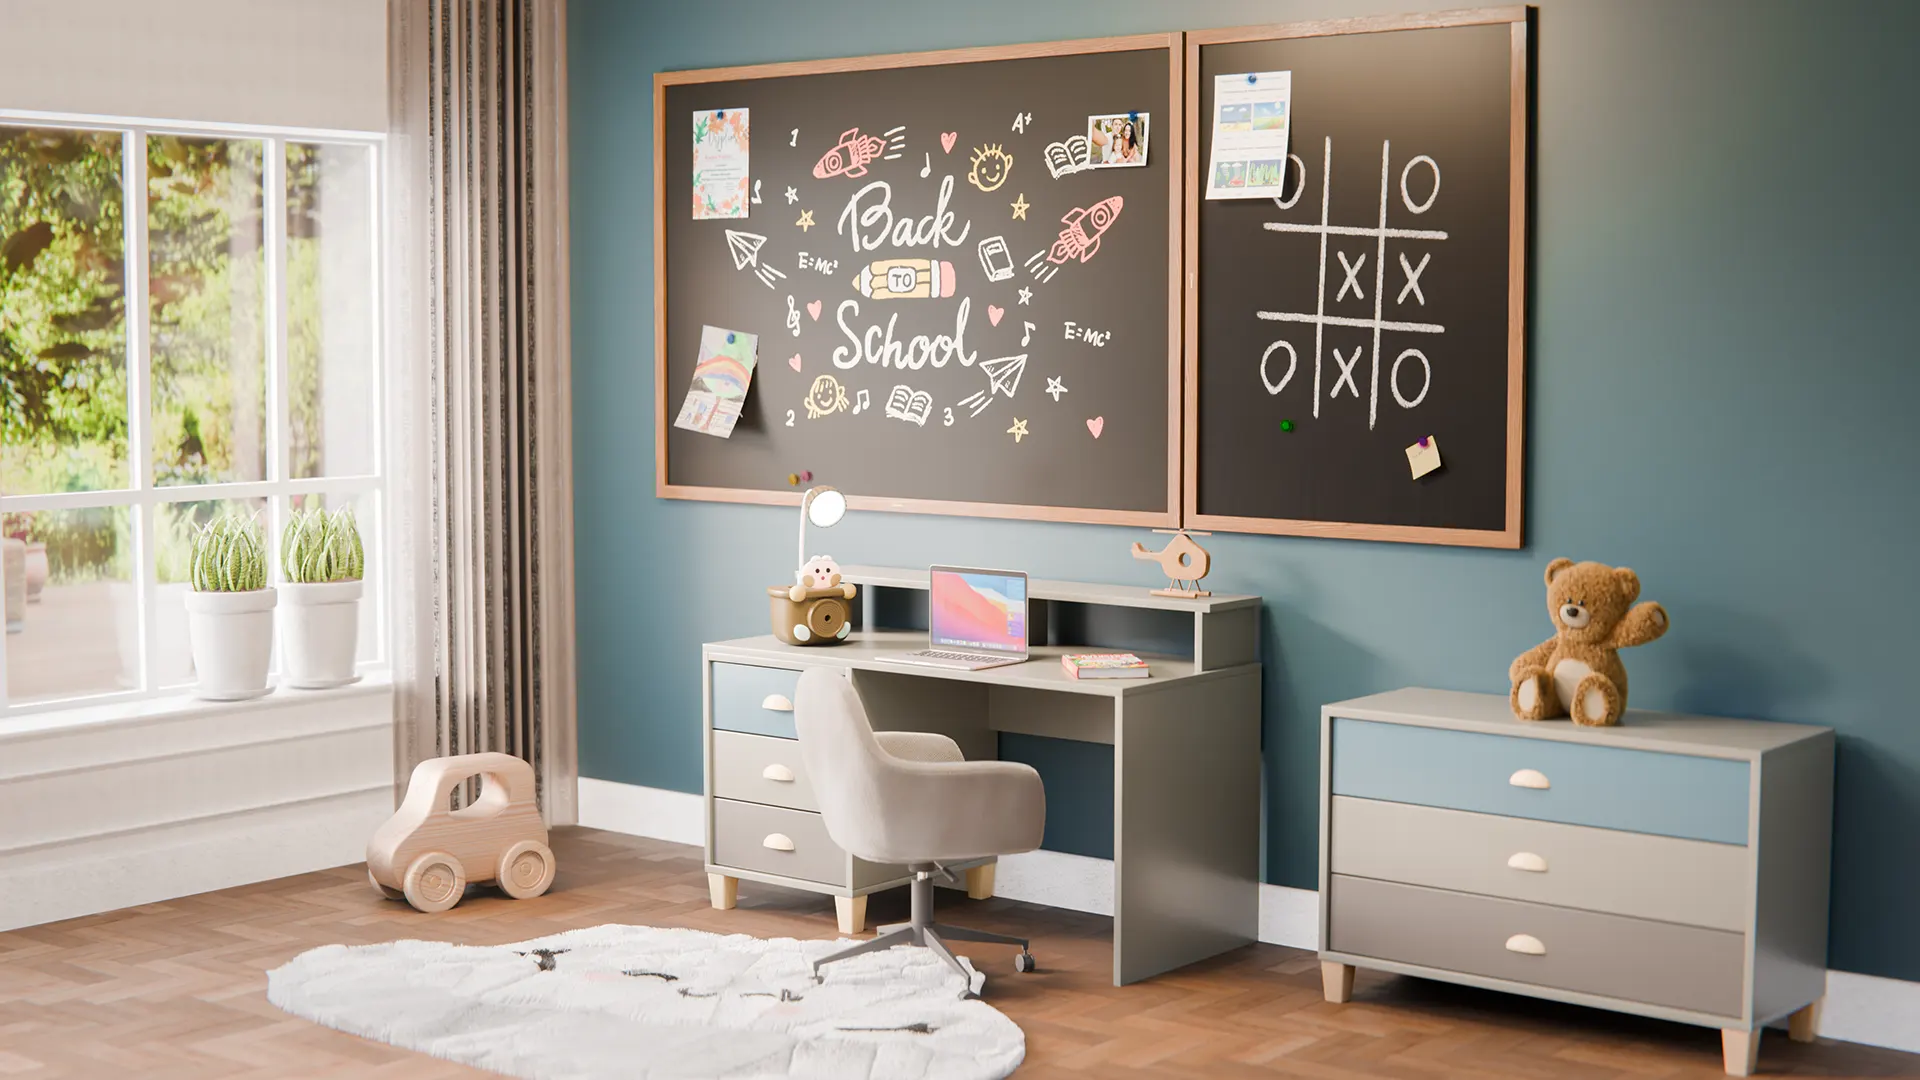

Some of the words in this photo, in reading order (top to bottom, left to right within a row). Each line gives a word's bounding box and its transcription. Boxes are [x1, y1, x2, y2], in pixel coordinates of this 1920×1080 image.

[1011, 112, 1033, 135] A+
[789, 128, 799, 148] 1
[837, 174, 971, 253] Back
[892, 273, 912, 288] TO
[832, 296, 978, 371] School
[785, 409, 796, 427] 2
[943, 406, 955, 427] 3
